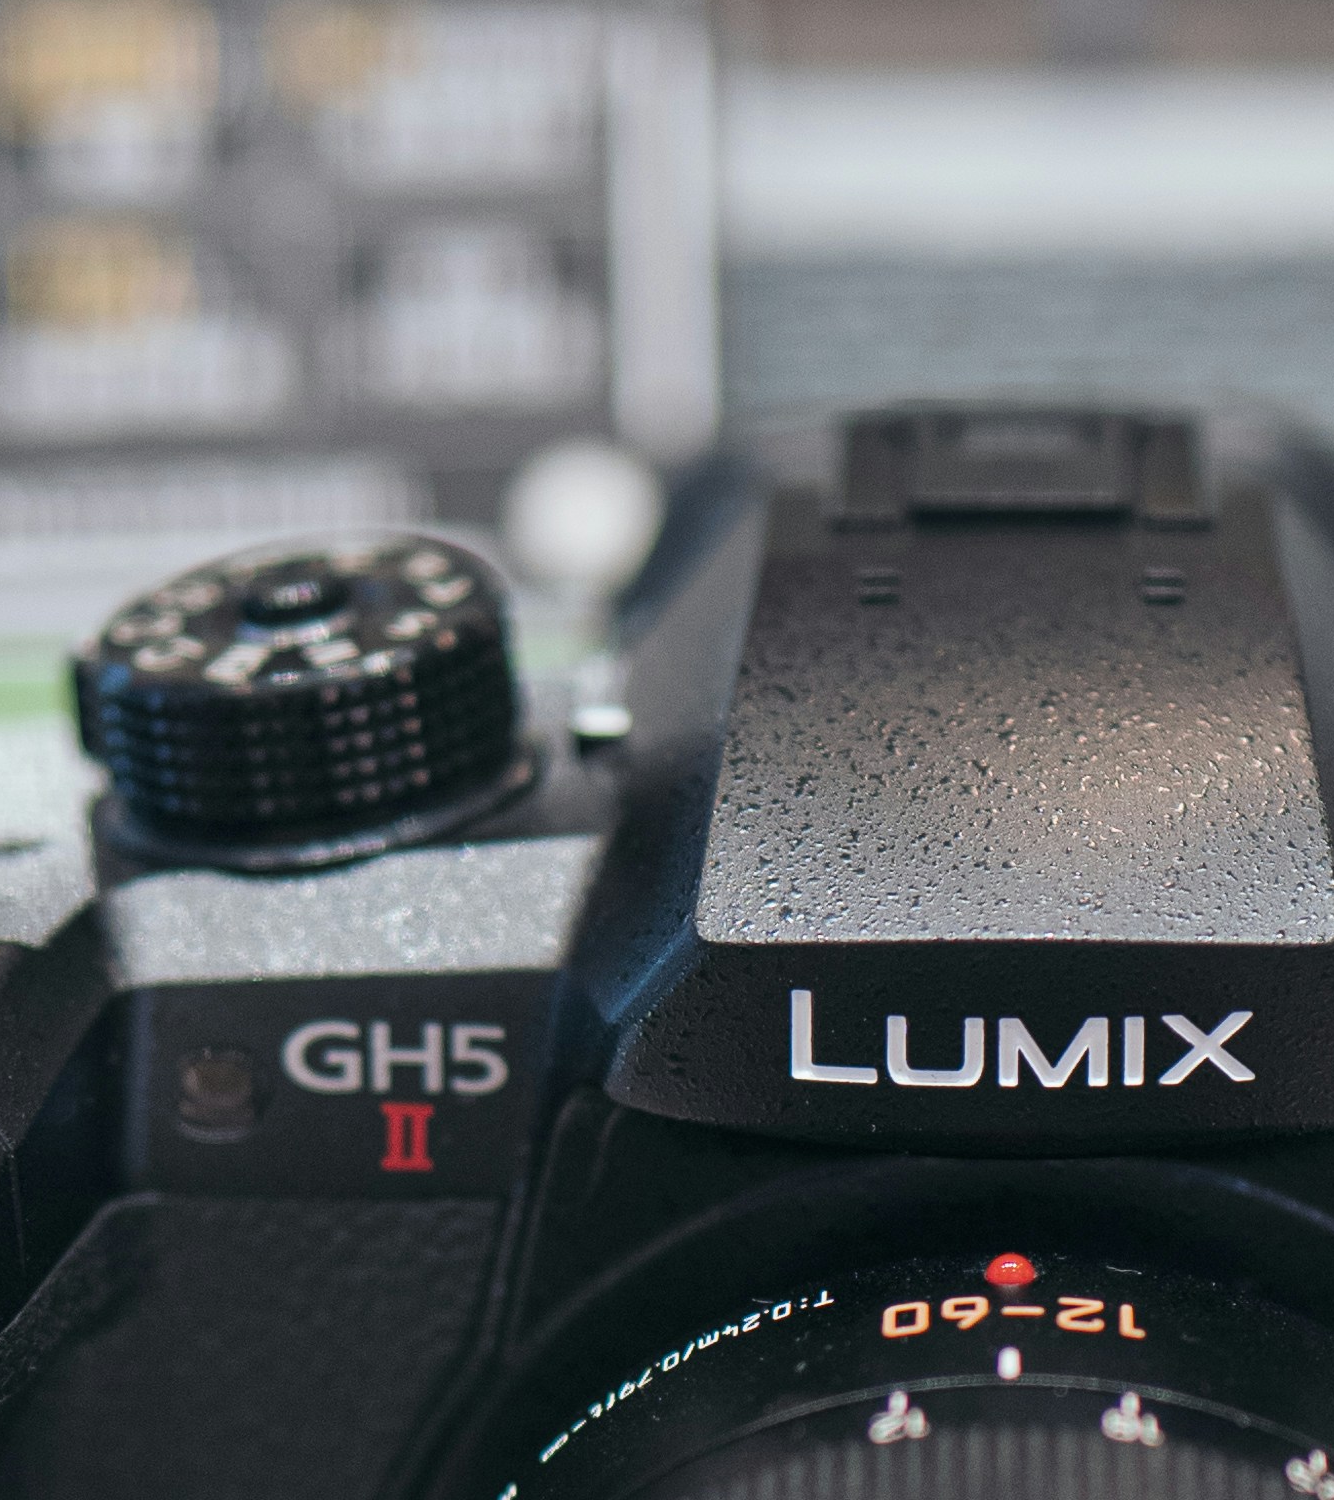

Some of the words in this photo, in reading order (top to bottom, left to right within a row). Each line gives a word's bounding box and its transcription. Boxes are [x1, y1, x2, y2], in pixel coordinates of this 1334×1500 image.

[282, 1020, 510, 1096] GH5
[379, 1102, 435, 1171] II
[881, 1295, 1147, 1340] 12-60
